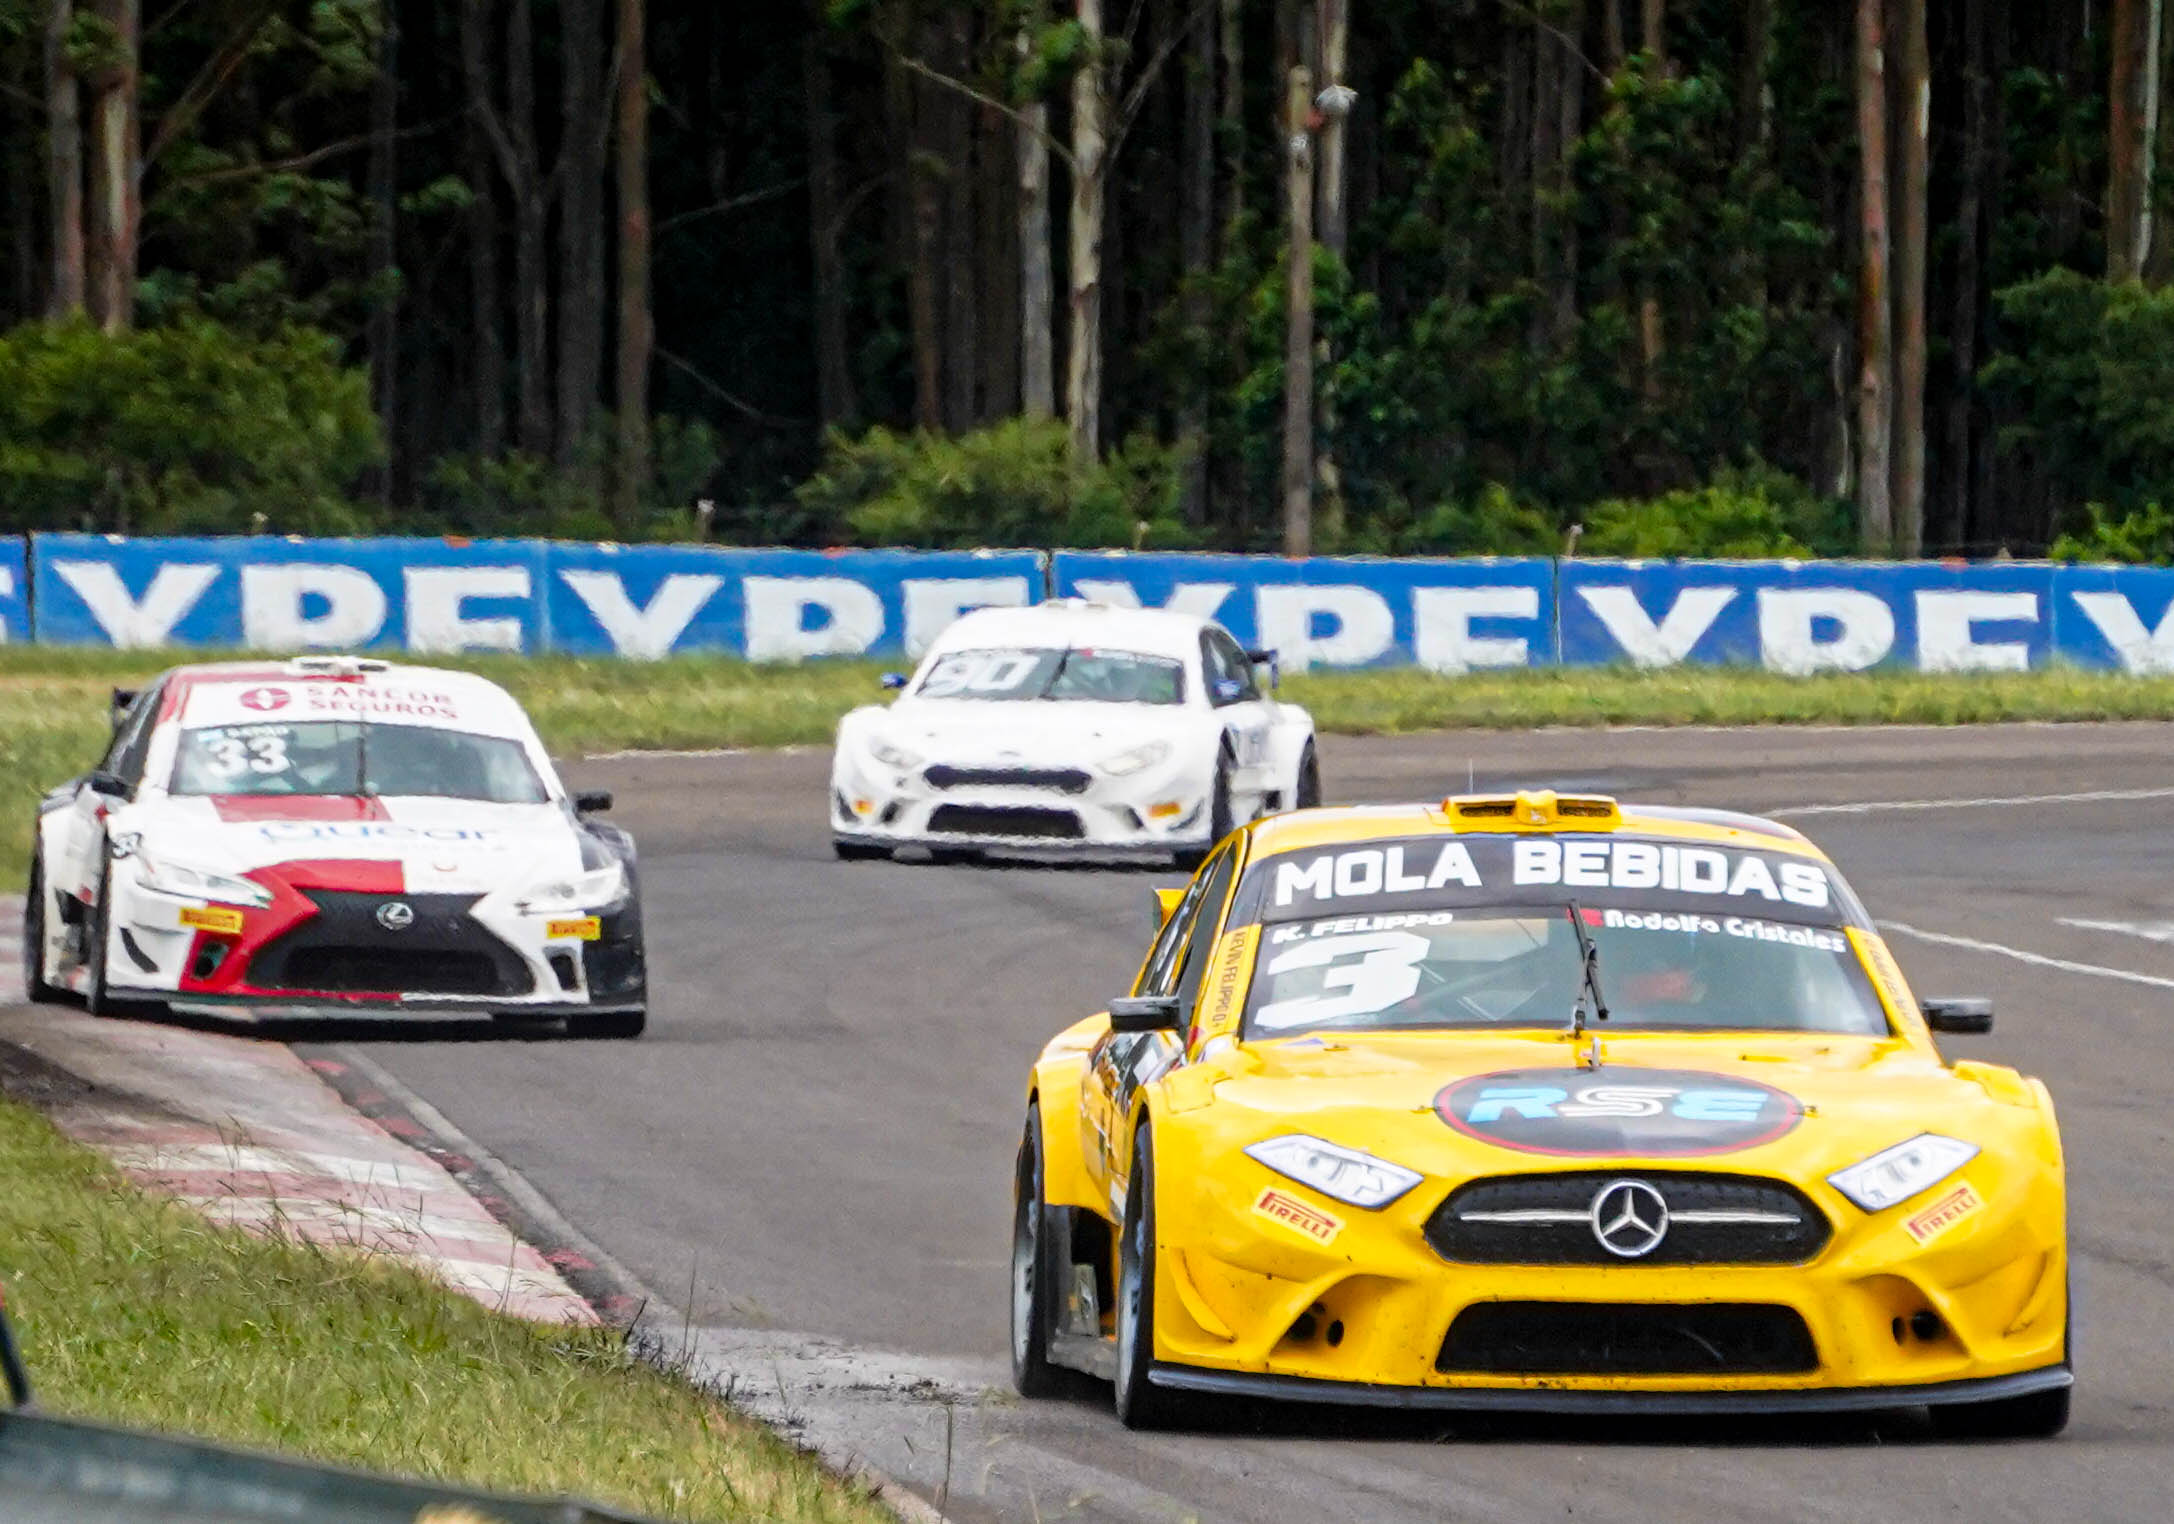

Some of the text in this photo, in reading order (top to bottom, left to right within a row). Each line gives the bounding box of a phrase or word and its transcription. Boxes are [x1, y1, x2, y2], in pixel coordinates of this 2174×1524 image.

[306, 686, 454, 705] SANCOR
[309, 700, 460, 721] SEGUROS
[207, 735, 292, 779] 33
[1275, 840, 1831, 908] MOLA BEBIDAS
[1272, 912, 1453, 945] K. FELIPPO
[1723, 917, 1847, 953] Cristales
[1254, 931, 1431, 1029] 3
[1467, 1085, 1769, 1123] RSE
[1258, 1191, 1337, 1240] PIRELLI
[1907, 1187, 1977, 1239] PIRELLI
